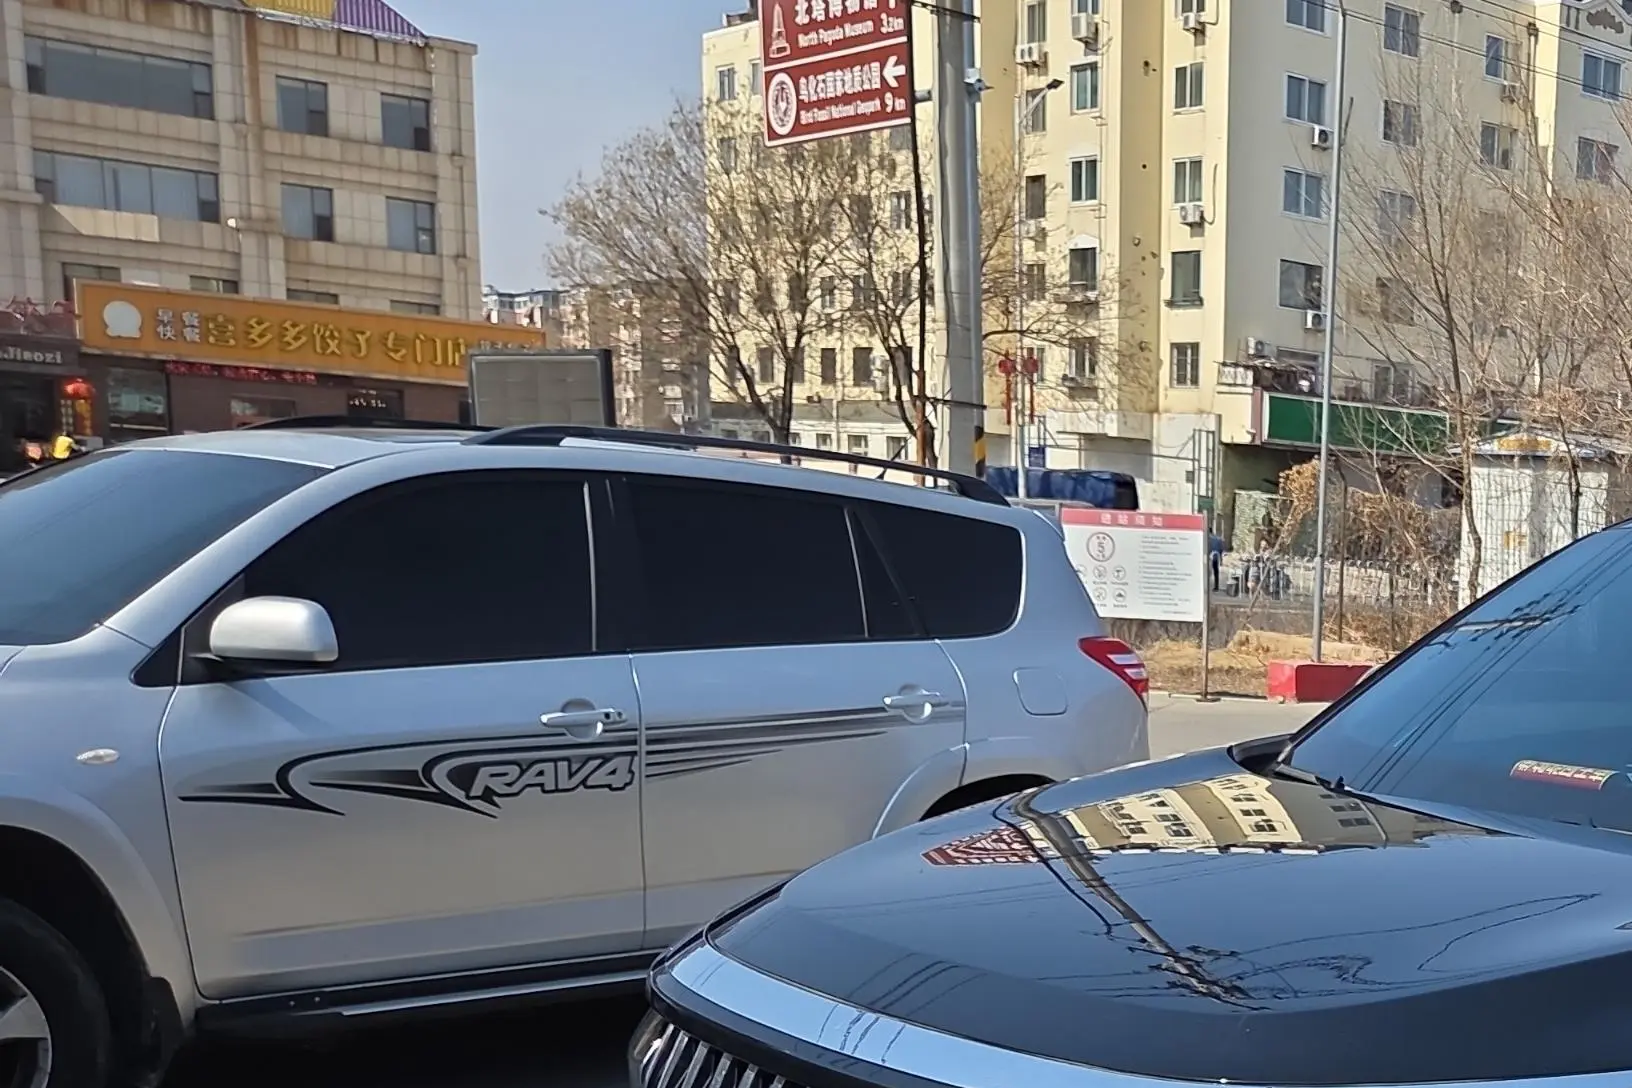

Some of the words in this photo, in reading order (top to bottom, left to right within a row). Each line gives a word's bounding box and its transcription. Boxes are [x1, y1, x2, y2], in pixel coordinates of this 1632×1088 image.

[884, 91, 893, 113] 9
[0, 346, 63, 364] Jiaozi
[468, 754, 634, 799] RAV4
